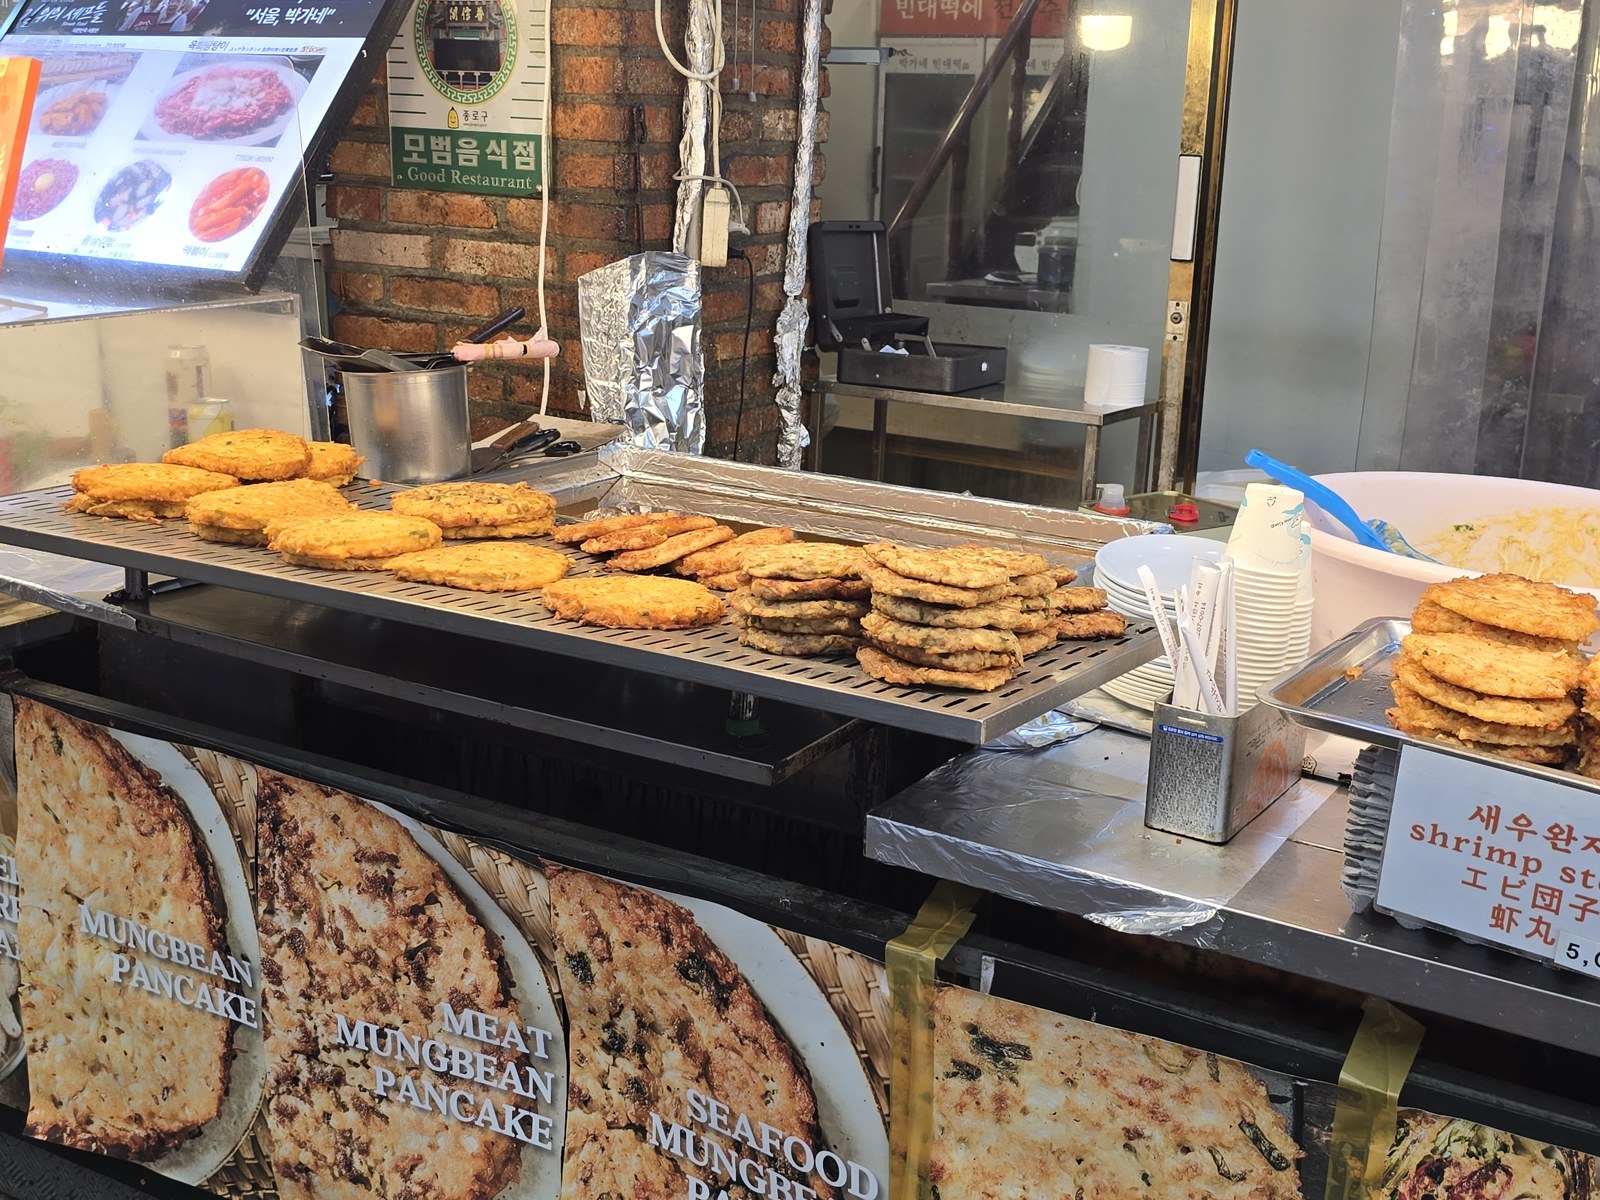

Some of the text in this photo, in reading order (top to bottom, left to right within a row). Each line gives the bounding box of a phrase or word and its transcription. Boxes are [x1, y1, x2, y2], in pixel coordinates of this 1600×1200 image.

[463, 110, 488, 123] 종로구
[402, 133, 536, 171] 모범음식점
[407, 166, 532, 190] Good Restaurant
[1409, 822, 1600, 890] shrimp st
[1460, 866, 1600, 923] エビ団子
[1488, 903, 1557, 947] 虾丸
[78, 903, 253, 988] MUNGBEAN
[111, 952, 258, 1029] PANCAKE
[335, 1013, 555, 1104] MUNGBEAN
[440, 1001, 553, 1060] MEAT
[371, 1065, 553, 1151] PANCAKE
[686, 1088, 879, 1200] SEAFOOD
